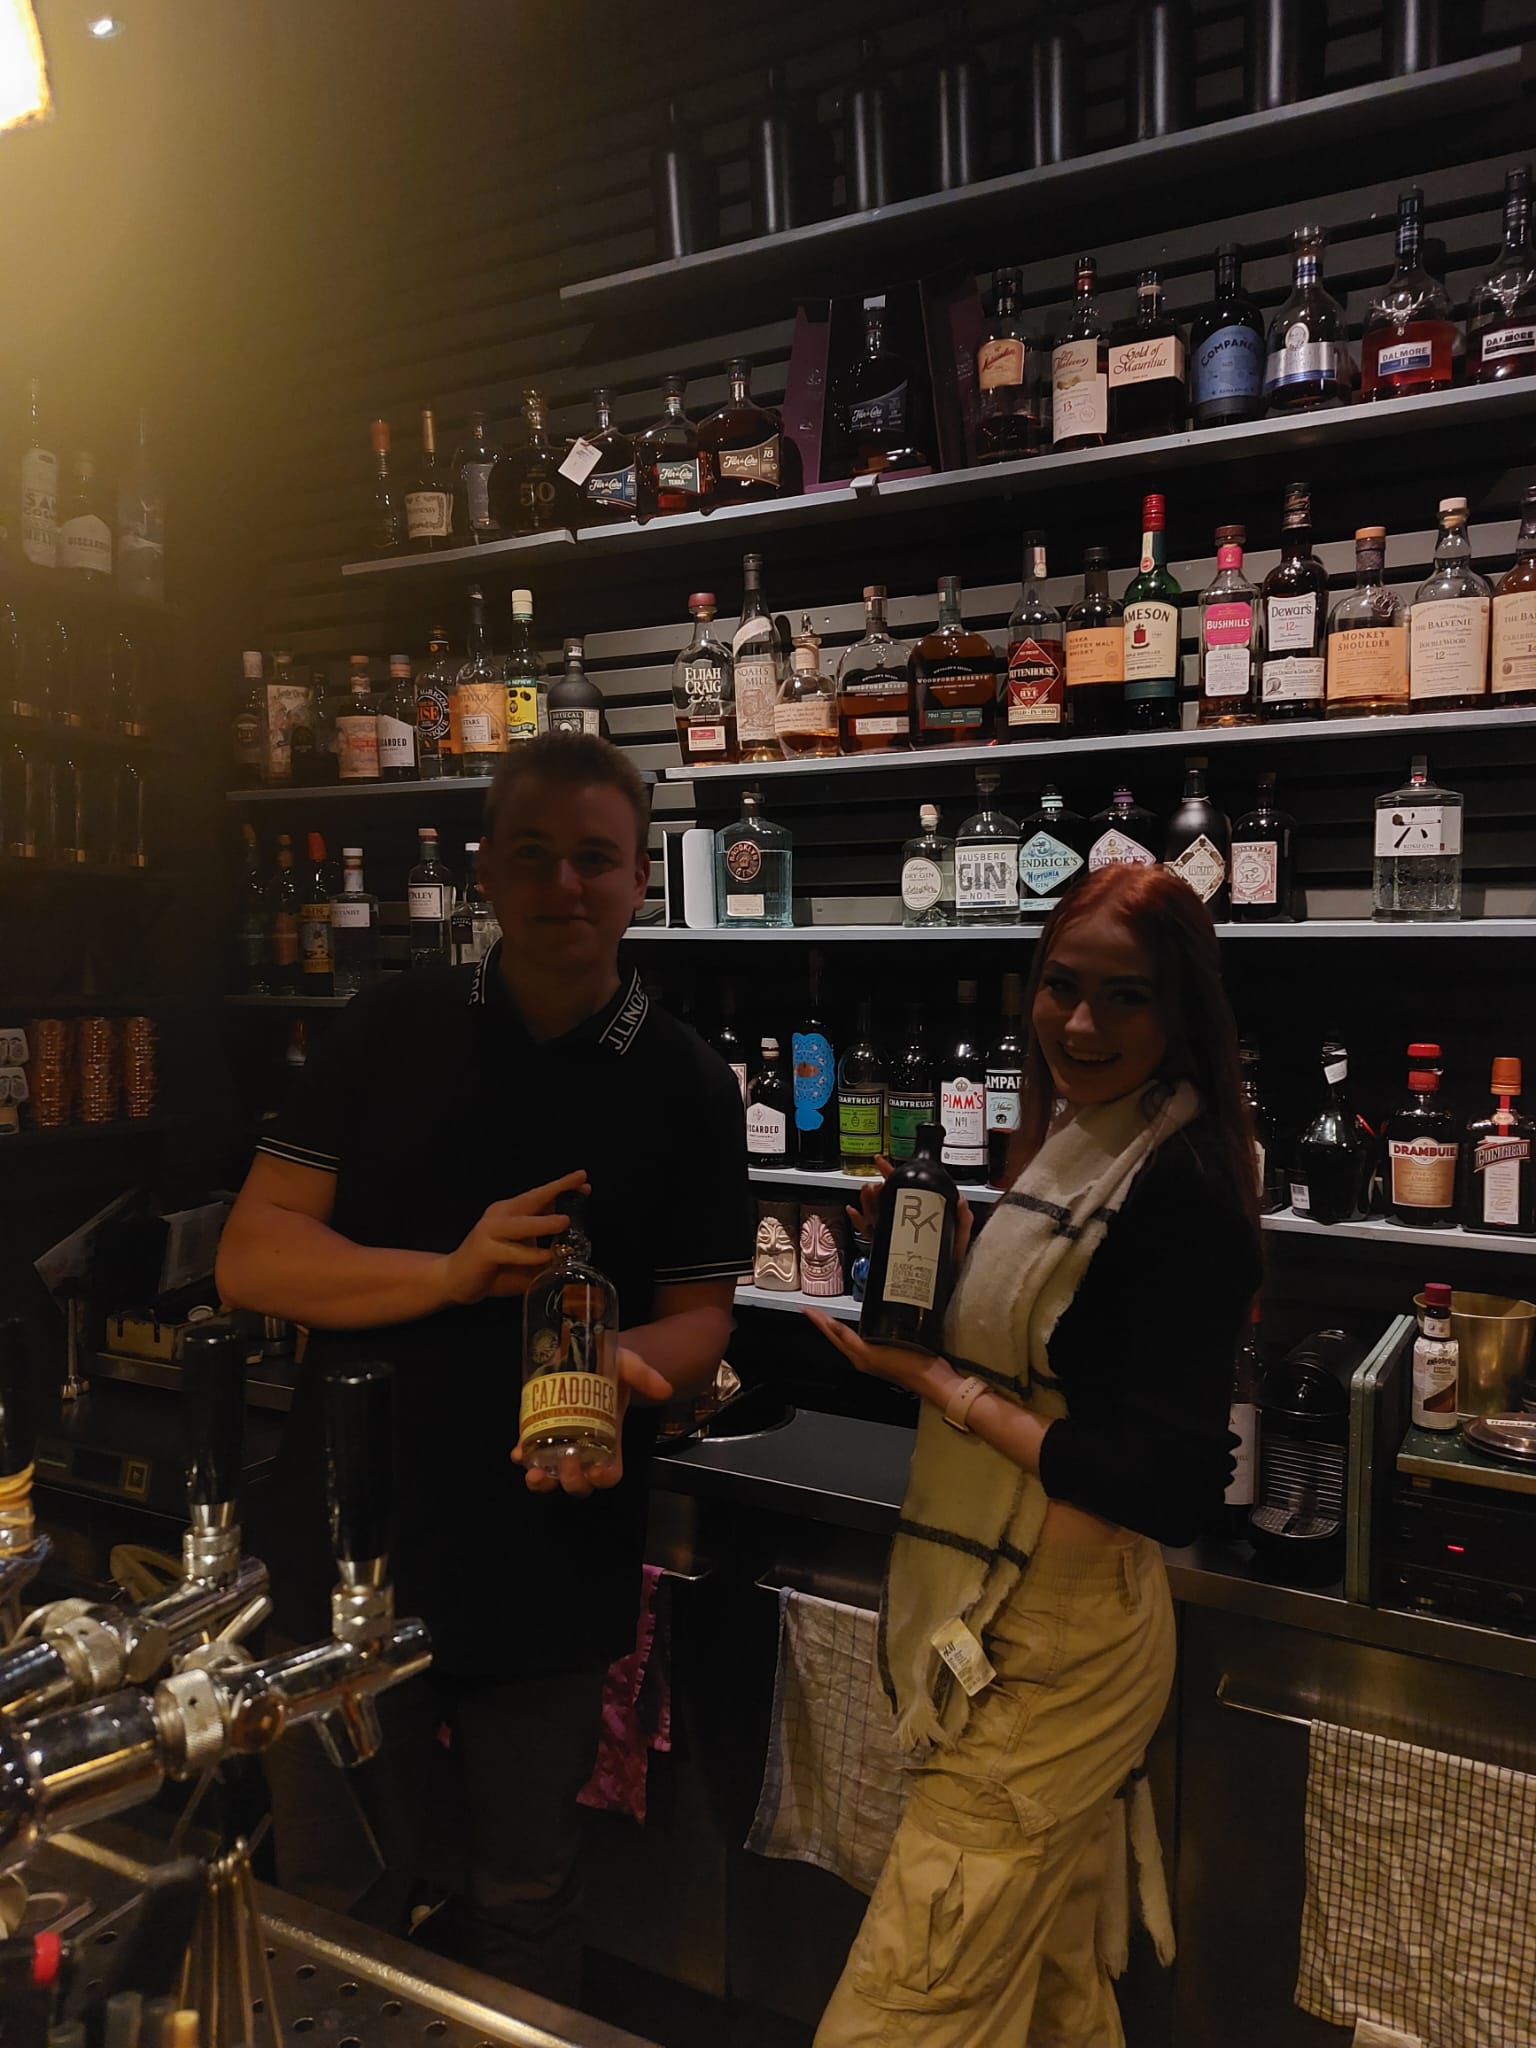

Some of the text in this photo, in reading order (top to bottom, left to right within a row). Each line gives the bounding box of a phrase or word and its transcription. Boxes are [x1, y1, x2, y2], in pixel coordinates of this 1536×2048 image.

[1149, 343, 1164, 358] of
[1383, 347, 1428, 362] DALMORE
[1113, 358, 1168, 375] Mauritius
[763, 449, 774, 458] 18
[1123, 608, 1171, 624] AMESON
[1272, 604, 1313, 618] Dewar's
[1207, 618, 1250, 630] BUSHMILLS
[1286, 622, 1296, 631] 12
[1428, 618, 1473, 630] BALVENIE
[1342, 631, 1386, 642] MONKEY
[1337, 640, 1390, 651] SHOULDER
[1435, 651, 1446, 660] 12
[685, 668, 721, 680] ELIJAH
[685, 680, 722, 695] CRAIG
[1020, 690, 1039, 698] RYE
[728, 843, 759, 862] BROOKLYN
[1020, 857, 1078, 868] ENDRICK'S
[959, 862, 1006, 891] GIN
[985, 1075, 1022, 1090] AMPA
[943, 1091, 984, 1110] PIMM'S
[1393, 1145, 1457, 1157] DRAMBUIE
[532, 1376, 614, 1414] CAZADORES
